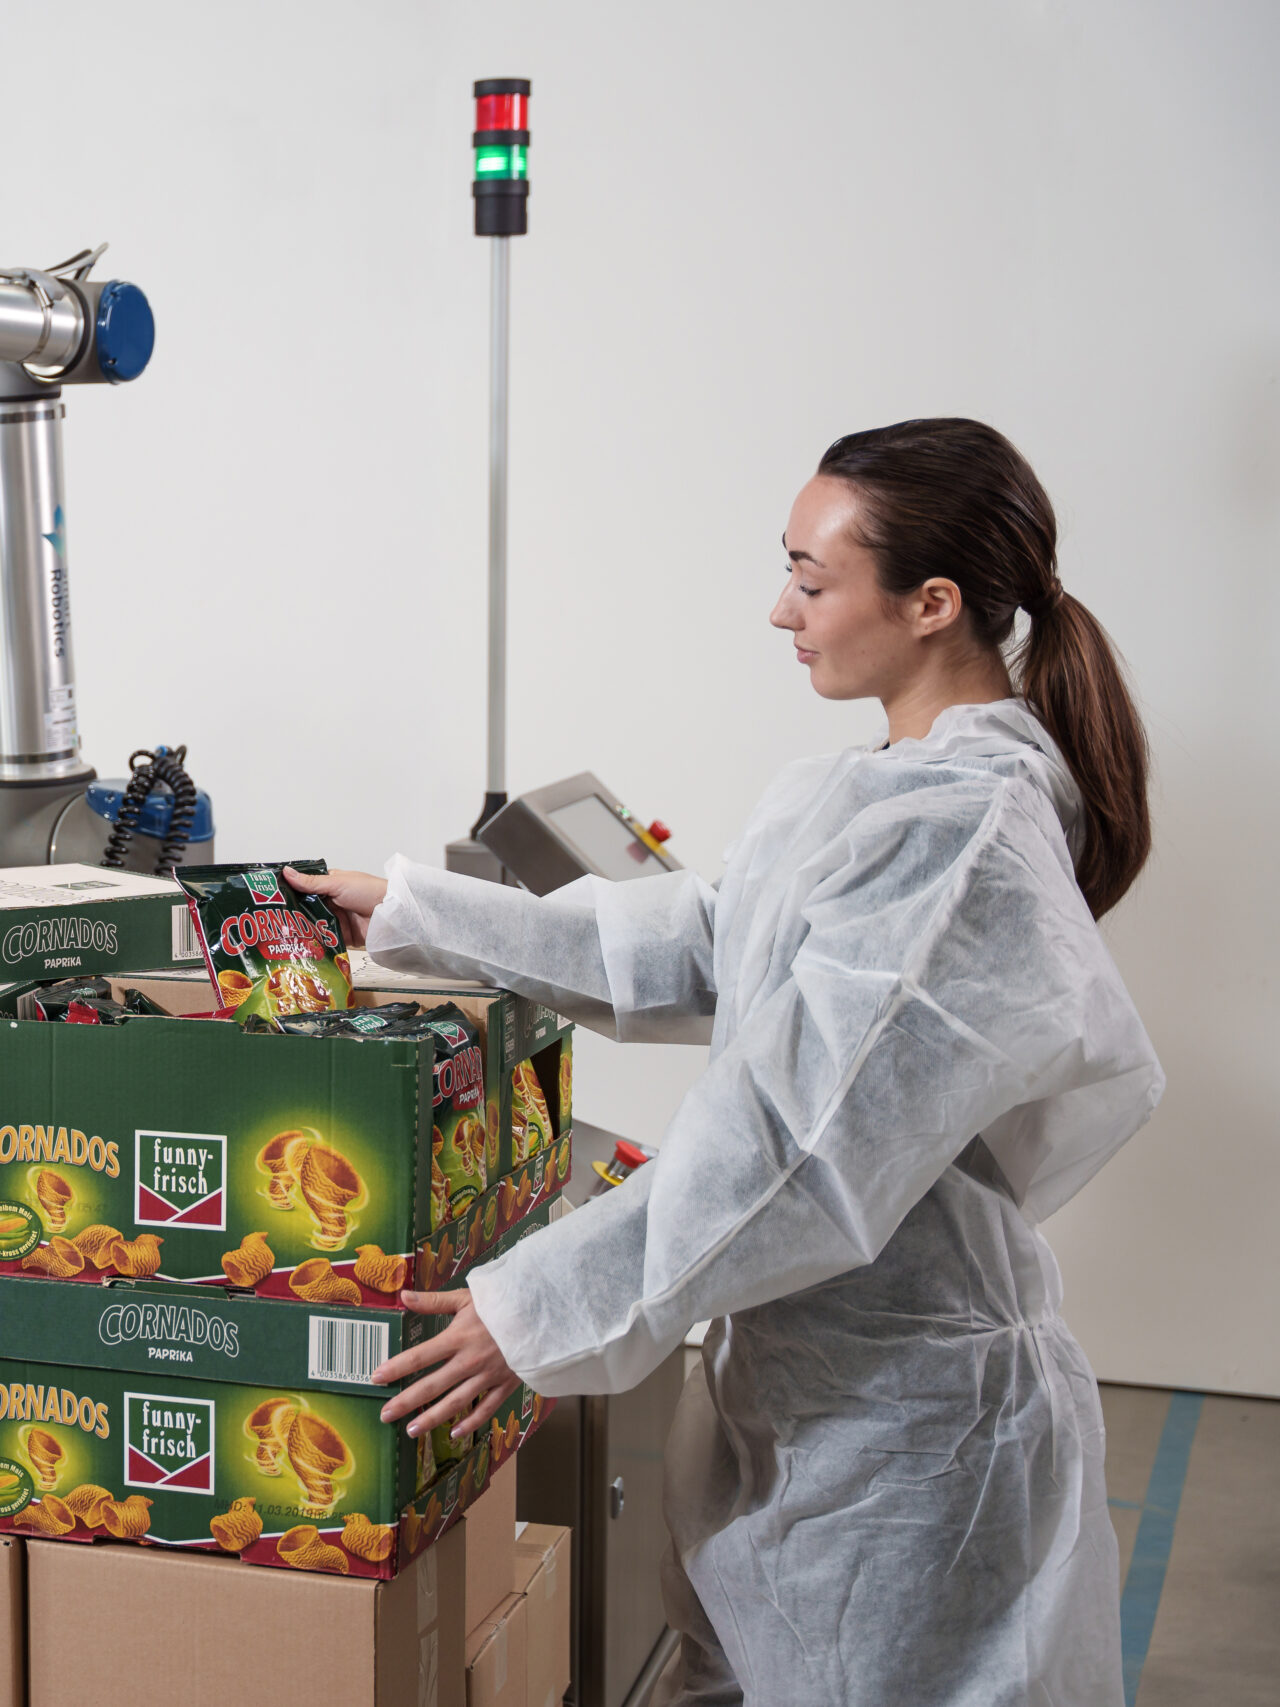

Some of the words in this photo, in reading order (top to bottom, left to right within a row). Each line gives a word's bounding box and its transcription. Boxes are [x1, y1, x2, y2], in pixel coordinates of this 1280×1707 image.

[50, 568, 65, 658] Robotics
[2, 917, 118, 964] CORNADOS
[153, 1138, 214, 1170] funny-
[153, 1167, 209, 1195] frisch
[99, 1304, 239, 1358] CORNADOS
[142, 1401, 202, 1434] funny-
[143, 1431, 196, 1458] frisch
